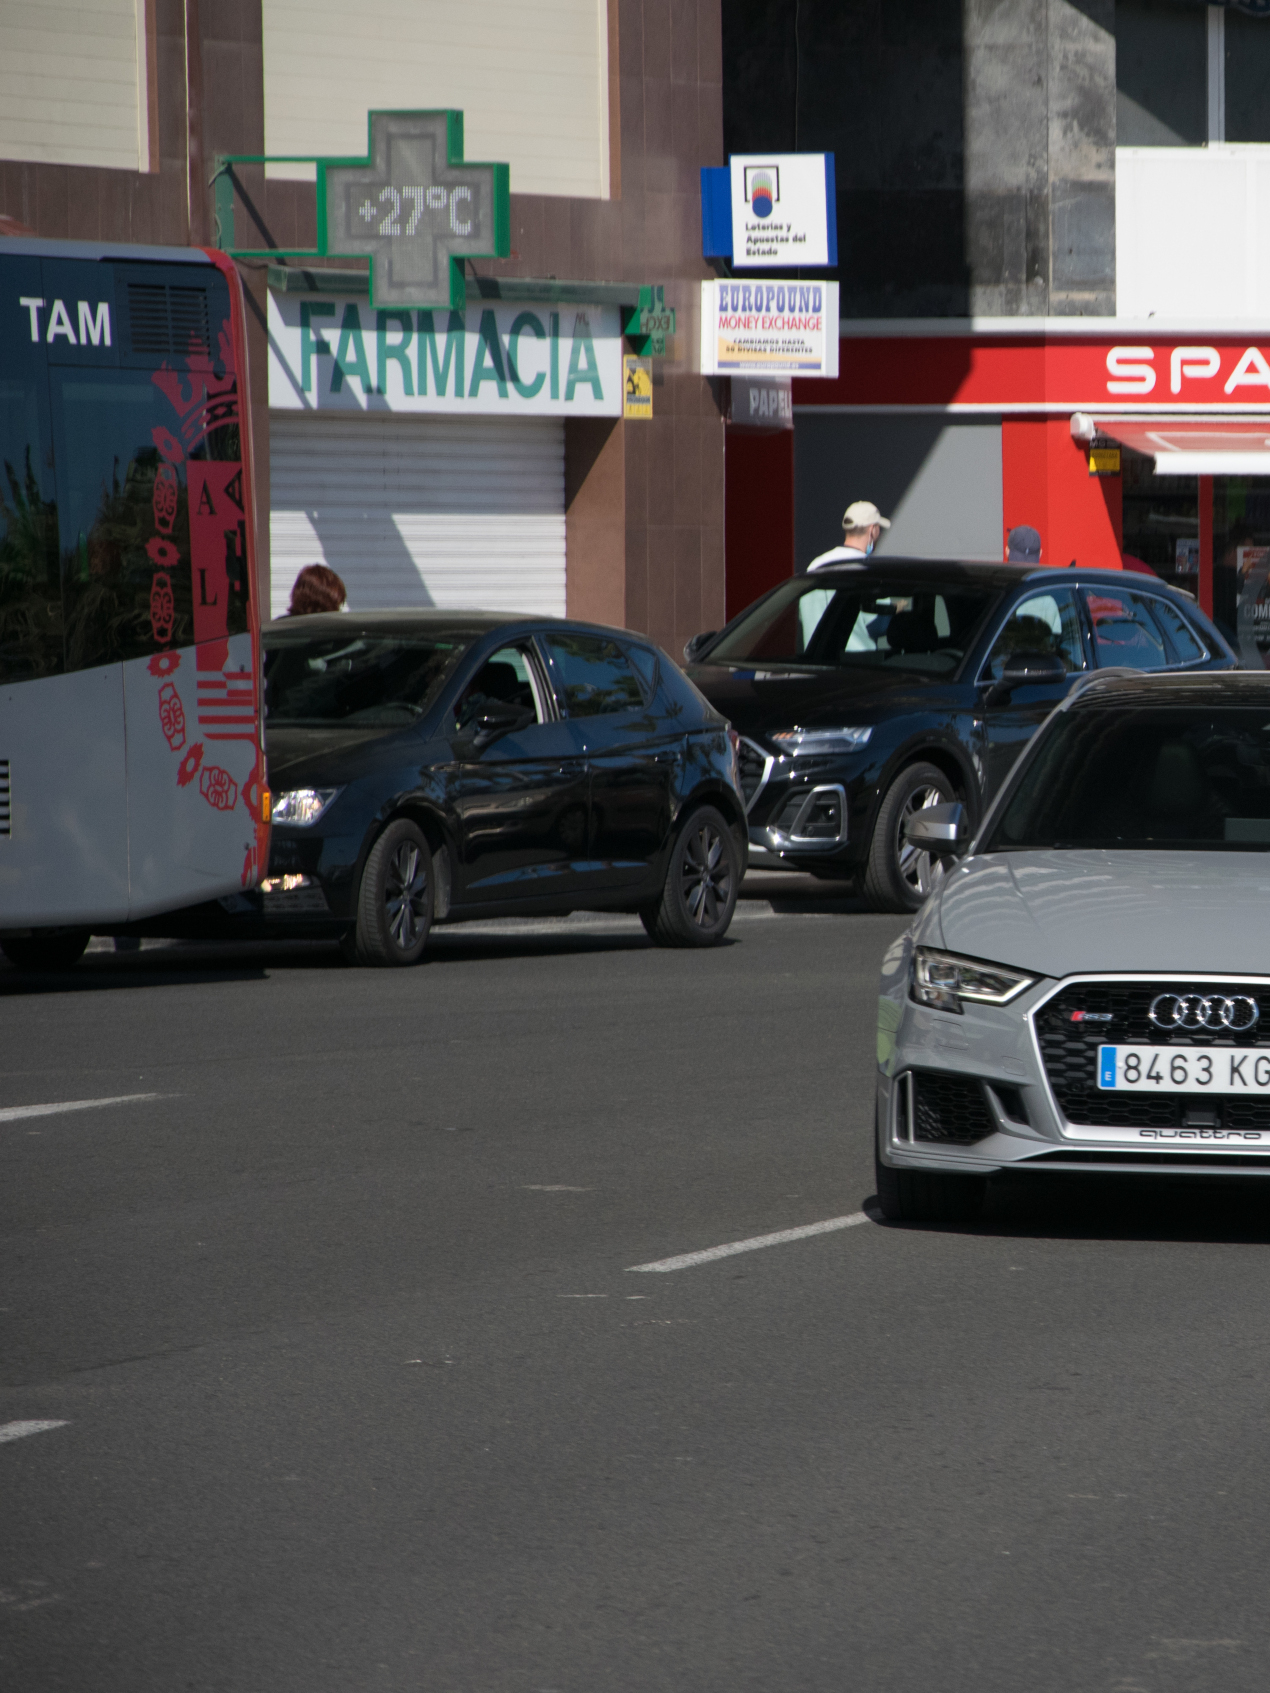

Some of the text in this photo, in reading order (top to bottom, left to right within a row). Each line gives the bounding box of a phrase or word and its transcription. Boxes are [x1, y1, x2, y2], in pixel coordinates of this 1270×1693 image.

[787, 223, 792, 232] y
[747, 233, 806, 245] Apuestas del
[746, 247, 778, 256] Estado
[719, 285, 822, 313] EUROPOUND
[19, 296, 112, 347] TAM
[719, 315, 822, 331] MONEY EXCHANGE
[300, 301, 604, 402] FARMACIA
[1124, 1052, 1213, 1085] 8463
[1139, 1129, 1262, 1140] quattro
